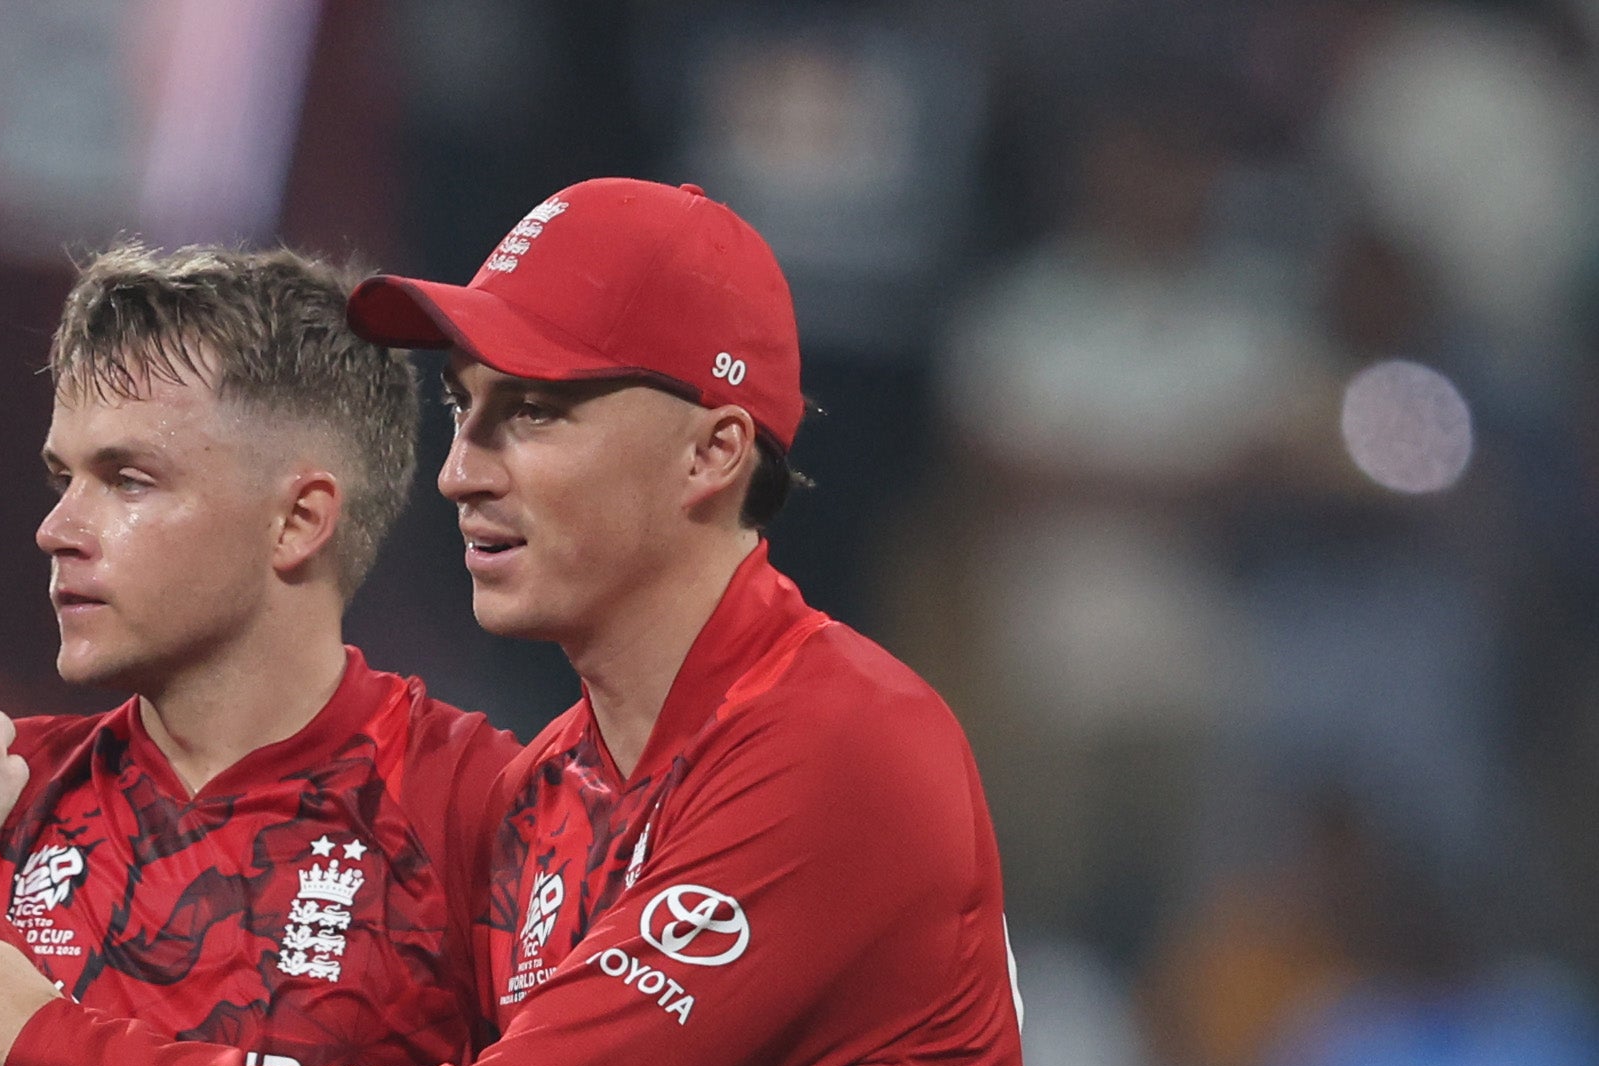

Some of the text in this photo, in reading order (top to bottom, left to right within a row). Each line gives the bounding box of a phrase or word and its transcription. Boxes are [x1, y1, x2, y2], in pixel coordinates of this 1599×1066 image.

[712, 352, 746, 386] 90
[16, 903, 46, 916] ICC
[40, 929, 74, 944] CUP
[56, 946, 81, 956] 2026
[508, 972, 535, 993] WORLD
